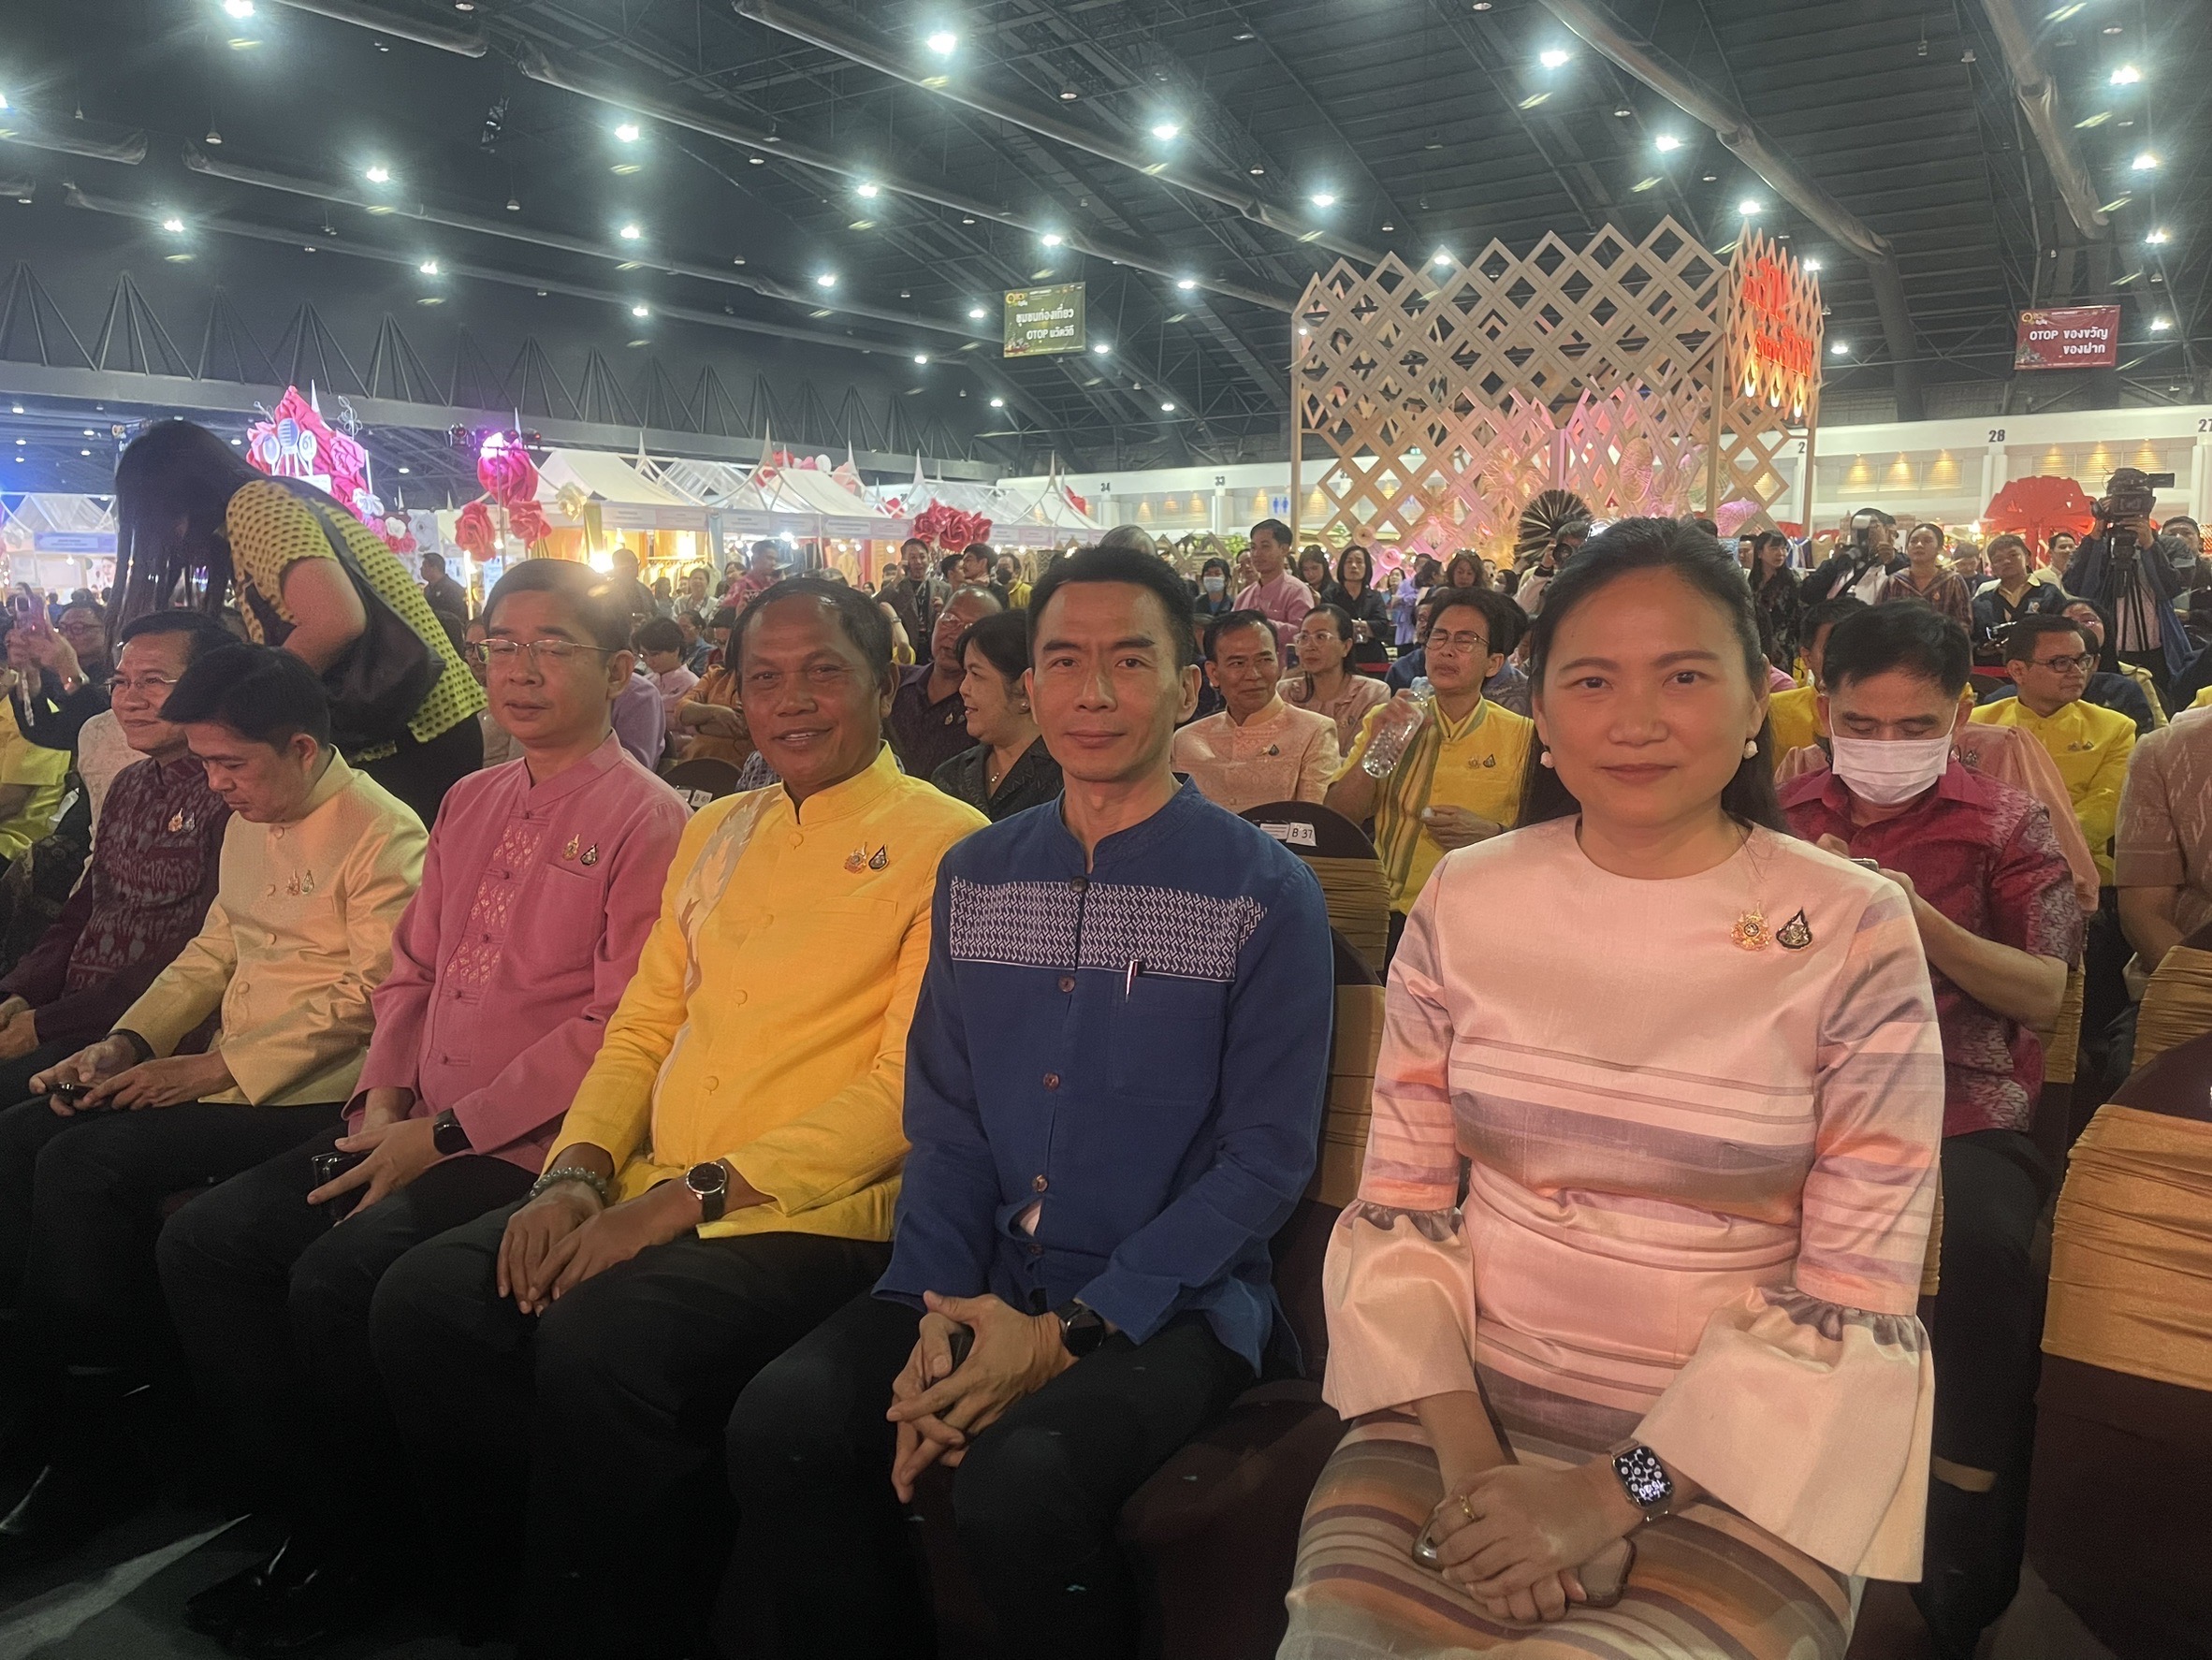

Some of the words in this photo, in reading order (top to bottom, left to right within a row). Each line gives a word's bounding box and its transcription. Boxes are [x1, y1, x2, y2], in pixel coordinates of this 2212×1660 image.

[1015, 303, 1075, 327] ชุมชนท่องเที่ยว
[1026, 330, 1048, 341] OTOP
[2029, 329, 2059, 341] OTOP
[2063, 326, 2108, 341] ของขวัญ
[2062, 342, 2105, 355] ของฝาก
[301, 434, 313, 450] 61
[1988, 429, 2005, 443] 28
[1291, 827, 1299, 837] B
[1302, 829, 1313, 839] 37
